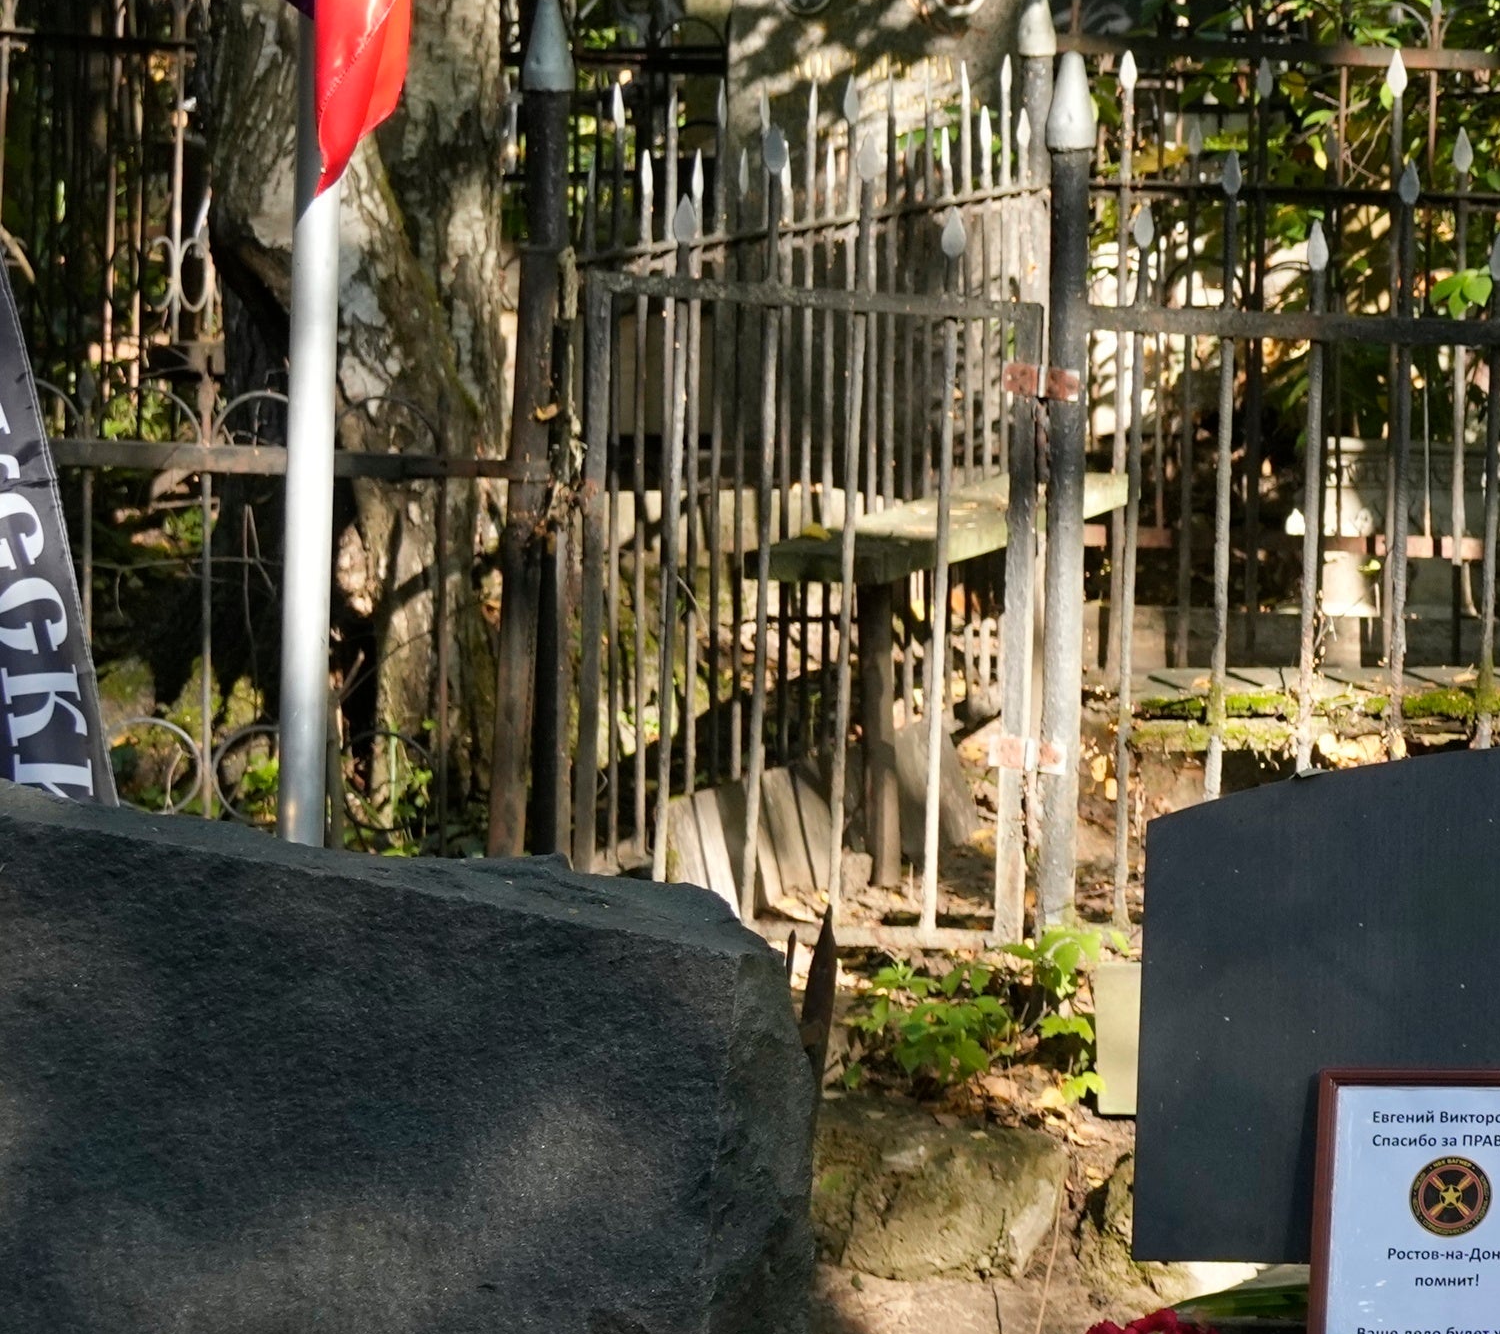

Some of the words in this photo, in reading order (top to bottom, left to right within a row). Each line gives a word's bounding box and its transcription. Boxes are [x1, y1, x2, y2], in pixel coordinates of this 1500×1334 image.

[1372, 1110, 1435, 1124] Евгений
[1372, 1133, 1437, 1147] Спасибо
[1441, 1137, 1457, 1147] за
[1414, 1273, 1479, 1287] помнит!
